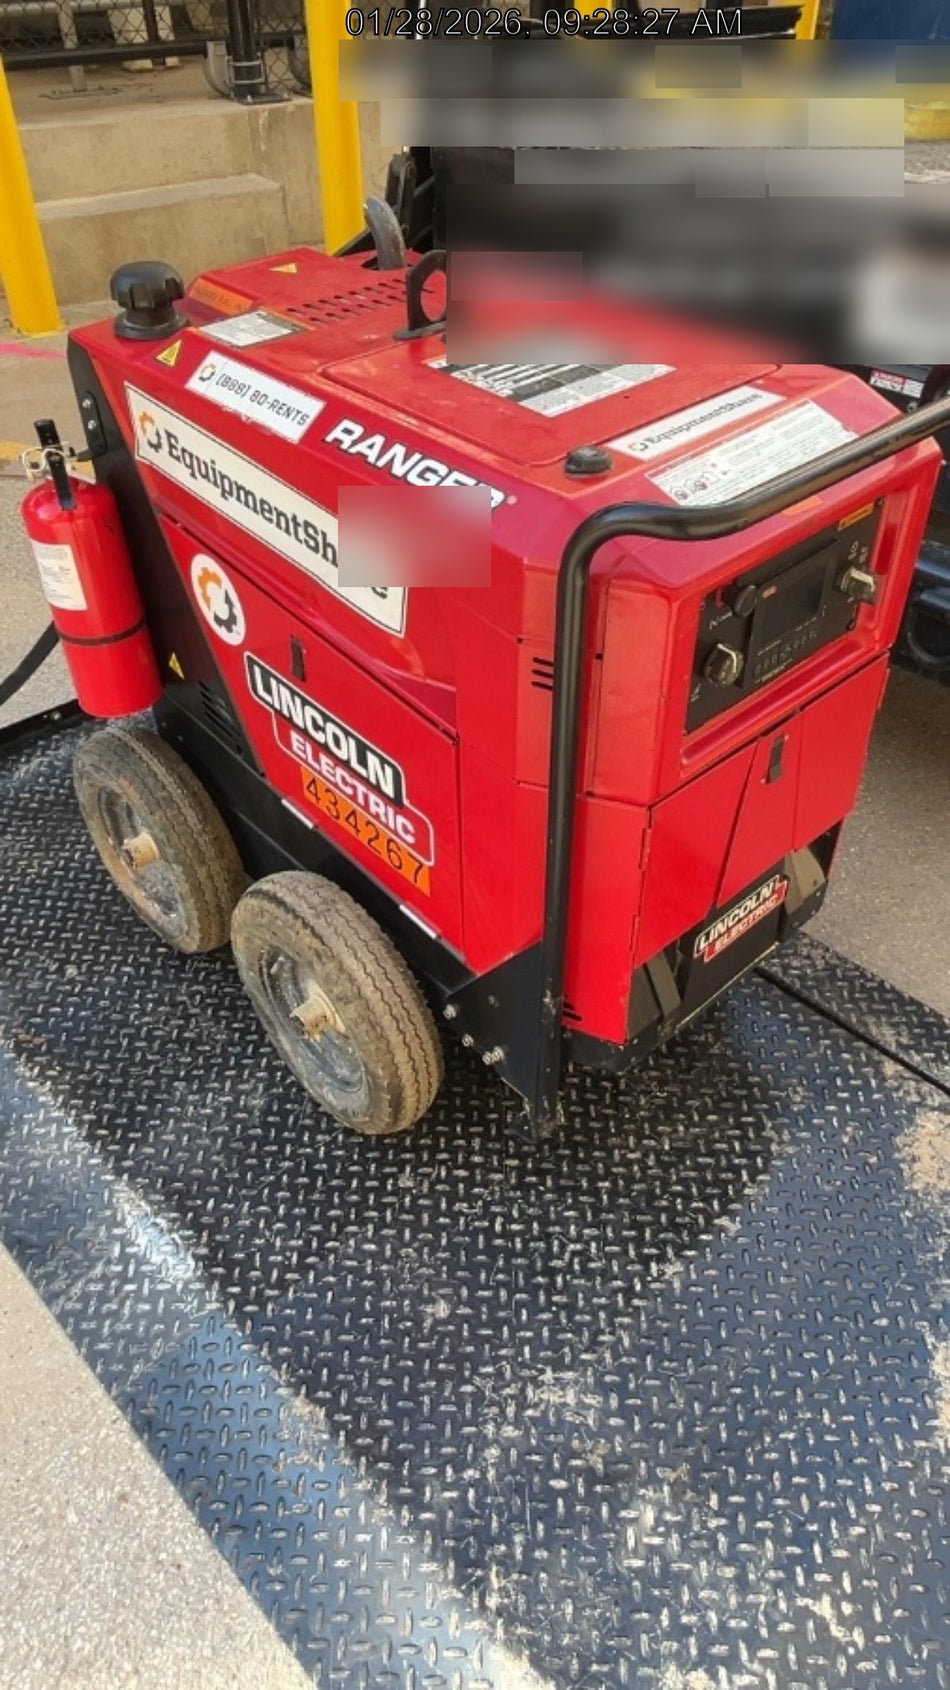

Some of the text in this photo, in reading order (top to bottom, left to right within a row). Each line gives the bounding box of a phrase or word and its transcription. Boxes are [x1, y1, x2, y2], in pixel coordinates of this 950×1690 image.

[249, 390, 311, 427] 80-RENTS
[164, 428, 389, 601] EquipmentShe
[253, 663, 395, 799] LINCOLN
[290, 729, 416, 844] ELECTRIC
[305, 776, 424, 885] 434267
[698, 880, 775, 951] LINCOLN
